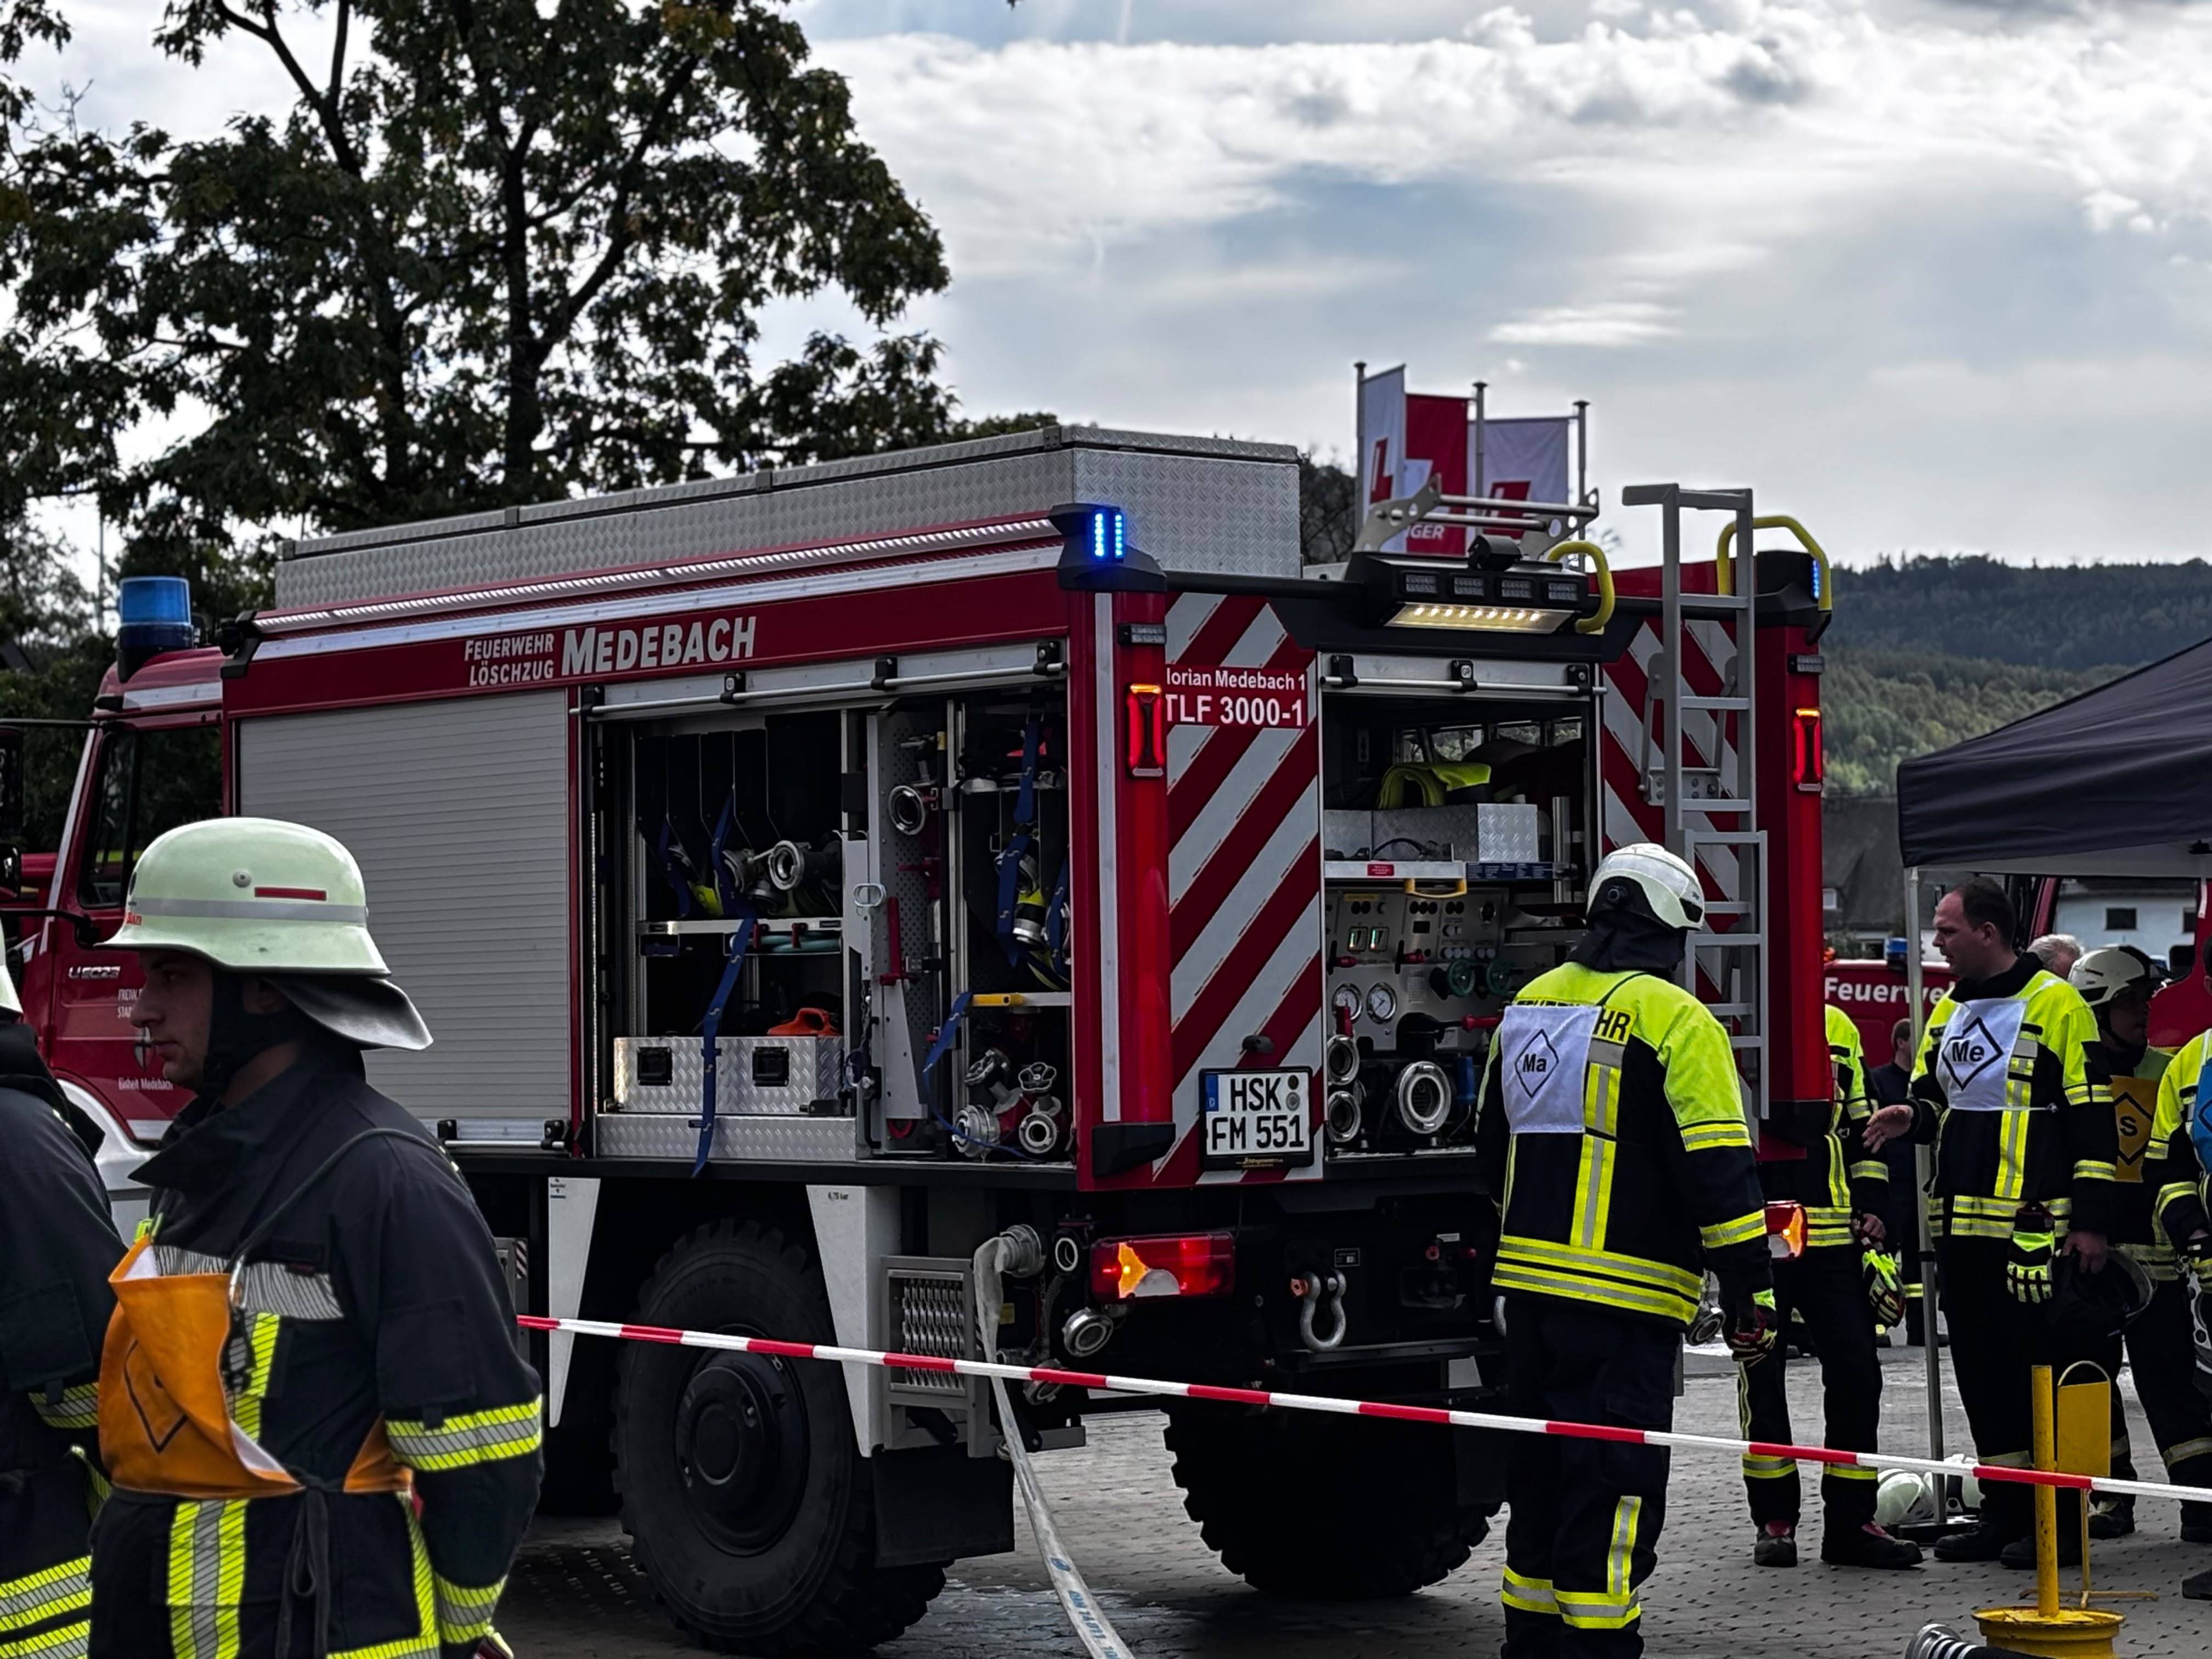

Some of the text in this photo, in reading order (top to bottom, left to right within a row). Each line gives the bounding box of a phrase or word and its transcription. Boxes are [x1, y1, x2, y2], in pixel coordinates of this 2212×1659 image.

[464, 633, 555, 662] FEUERWEHR
[561, 616, 757, 677] MEDEBACH
[469, 659, 554, 687] LÖSCHZUG
[1215, 669, 1295, 690] Medebach
[1298, 674, 1306, 691] 1
[1165, 693, 1302, 726] TLF 3000-1
[1522, 1053, 1547, 1073] Ma
[1952, 1040, 1985, 1062] Me
[1230, 1076, 1282, 1111] HSK
[1212, 1115, 1304, 1150] FM 551
[2119, 1115, 2138, 1137] S
